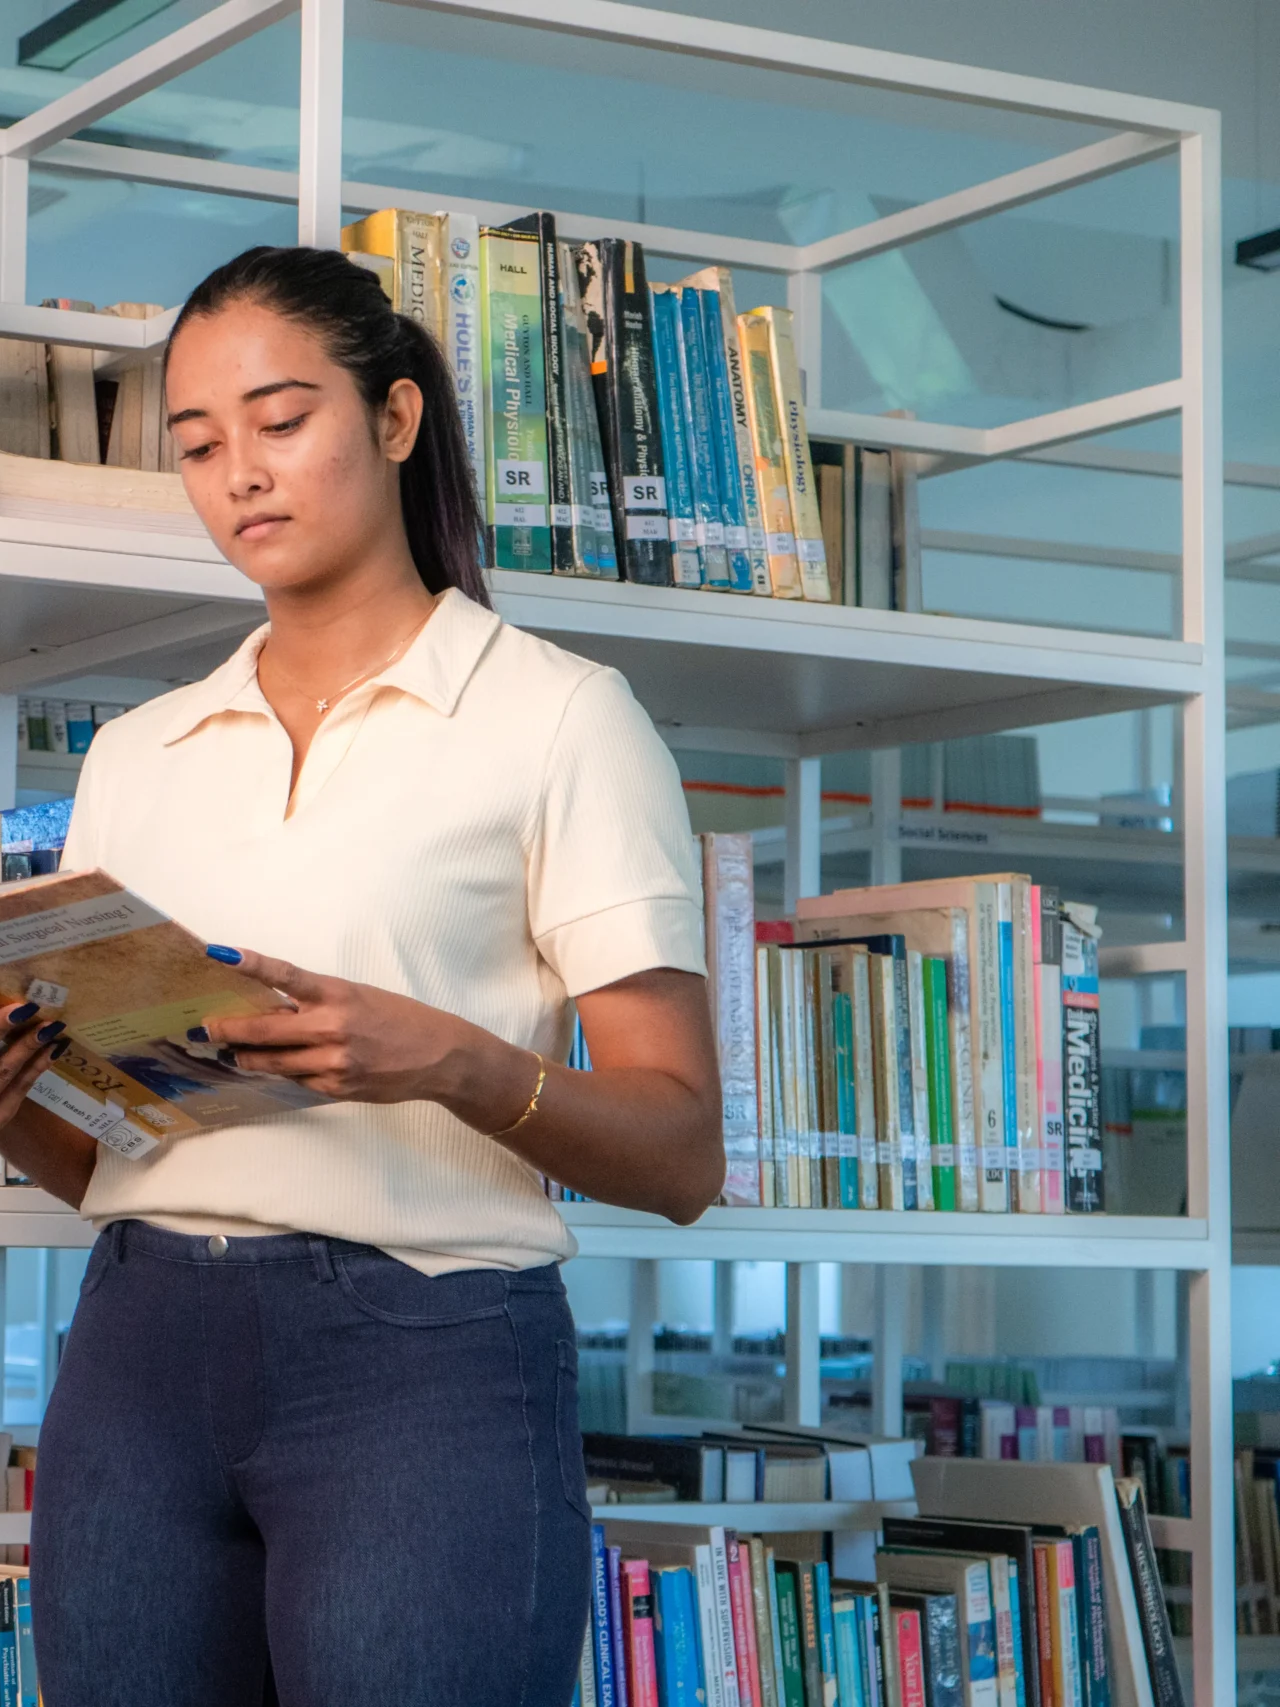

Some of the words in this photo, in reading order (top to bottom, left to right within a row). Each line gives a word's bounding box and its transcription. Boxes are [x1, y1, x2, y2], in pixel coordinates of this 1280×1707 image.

[500, 264, 527, 274] HALL
[547, 242, 555, 281] HUMAN
[548, 282, 556, 299] AND
[548, 300, 557, 334] SOCIAL
[455, 313, 472, 393] HOLE'S
[504, 314, 521, 383] Medical
[550, 336, 559, 375] BIOLOGY
[506, 471, 531, 485] SR
[633, 486, 658, 500] SR
[899, 826, 935, 838] Social
[938, 828, 988, 843] Sciences
[7, 922, 67, 943] Surgical
[65, 909, 128, 930] Nursing
[122, 905, 134, 914] I
[62, 1101, 85, 1117] Rakesh
[724, 1104, 747, 1119] SR
[987, 1110, 996, 1128] 6
[1047, 1121, 1063, 1136] SR
[120, 1136, 142, 1153] CBS
[714, 1546, 723, 1557] IN
[729, 1545, 738, 1562] 2
[716, 1558, 724, 1582] LOVE
[595, 1558, 608, 1628] MACLEOD'S
[719, 1583, 727, 1605] WITH
[1135, 1541, 1166, 1657] MICROBIOLOGY
[803, 1573, 816, 1648] DEAFNESS
[720, 1608, 733, 1667] SUPERVISION
[599, 1630, 611, 1681] CLINICAL
